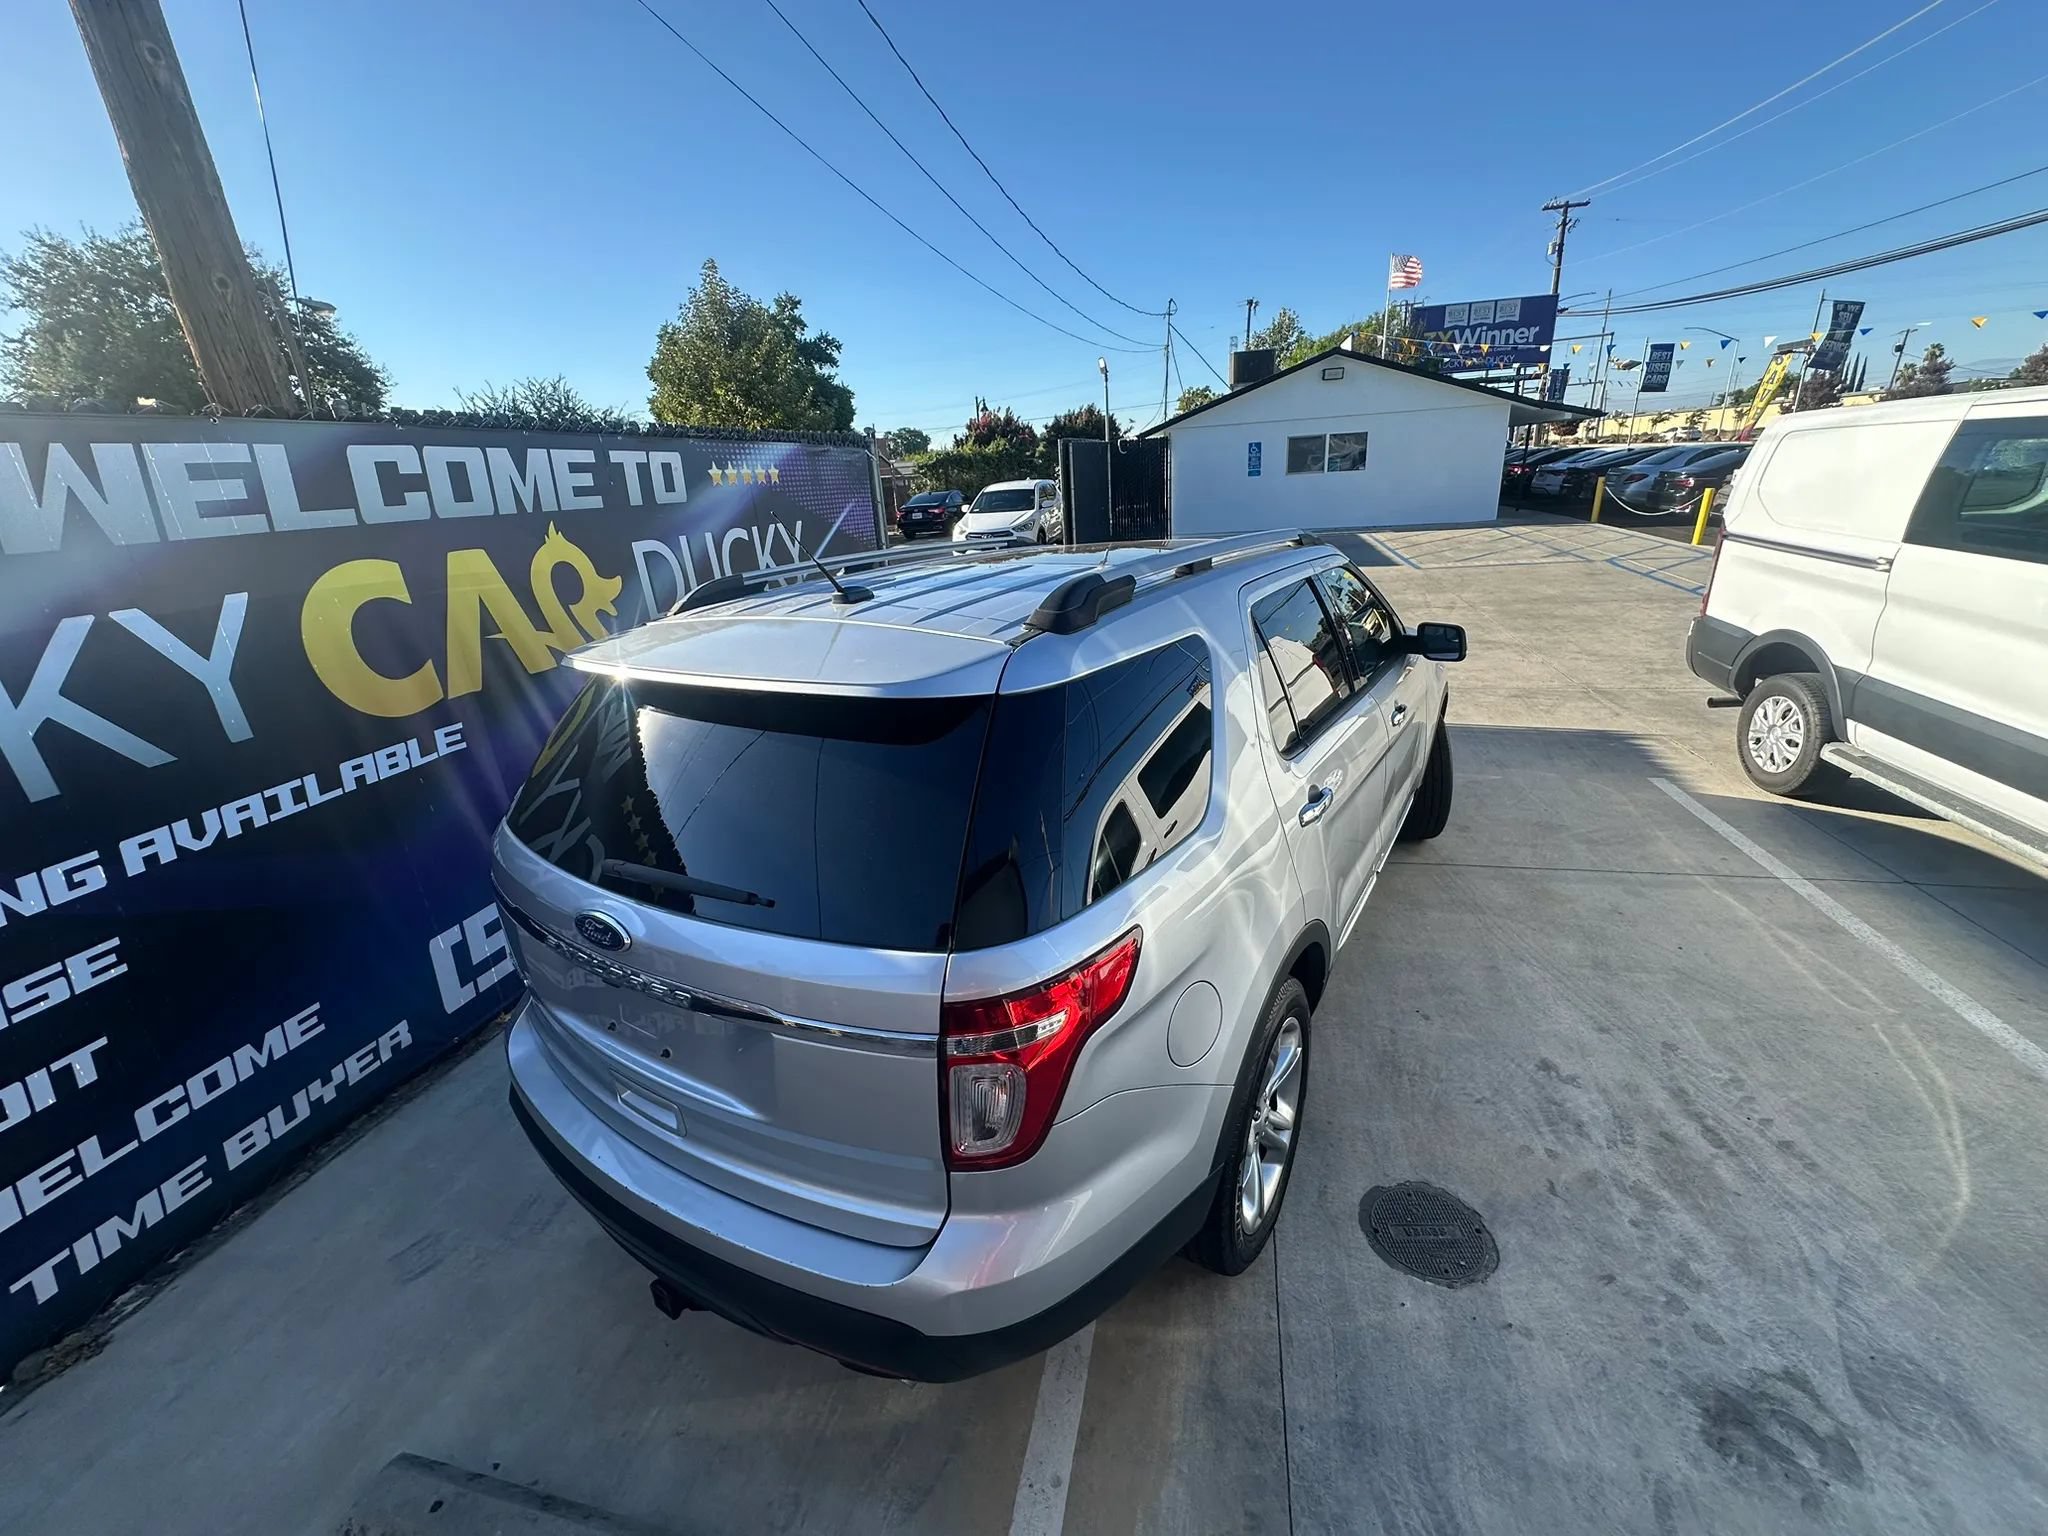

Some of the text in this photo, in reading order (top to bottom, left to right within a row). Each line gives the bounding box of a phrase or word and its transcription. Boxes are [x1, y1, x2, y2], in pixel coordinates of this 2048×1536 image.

[1455, 325, 1539, 347] Winner
[1647, 362, 1671, 373] USED
[1651, 351, 1673, 361] BEST
[1644, 374, 1668, 384] CARS
[0, 442, 687, 554] WELCOME TO
[0, 520, 807, 803] KY CAR DUCKY
[119, 722, 468, 878] AVAILABLE
[582, 918, 613, 945] Ford
[0, 936, 128, 1031] SE
[546, 934, 692, 1009] EXPLORER
[9, 1019, 413, 1305] TIME BUYER
